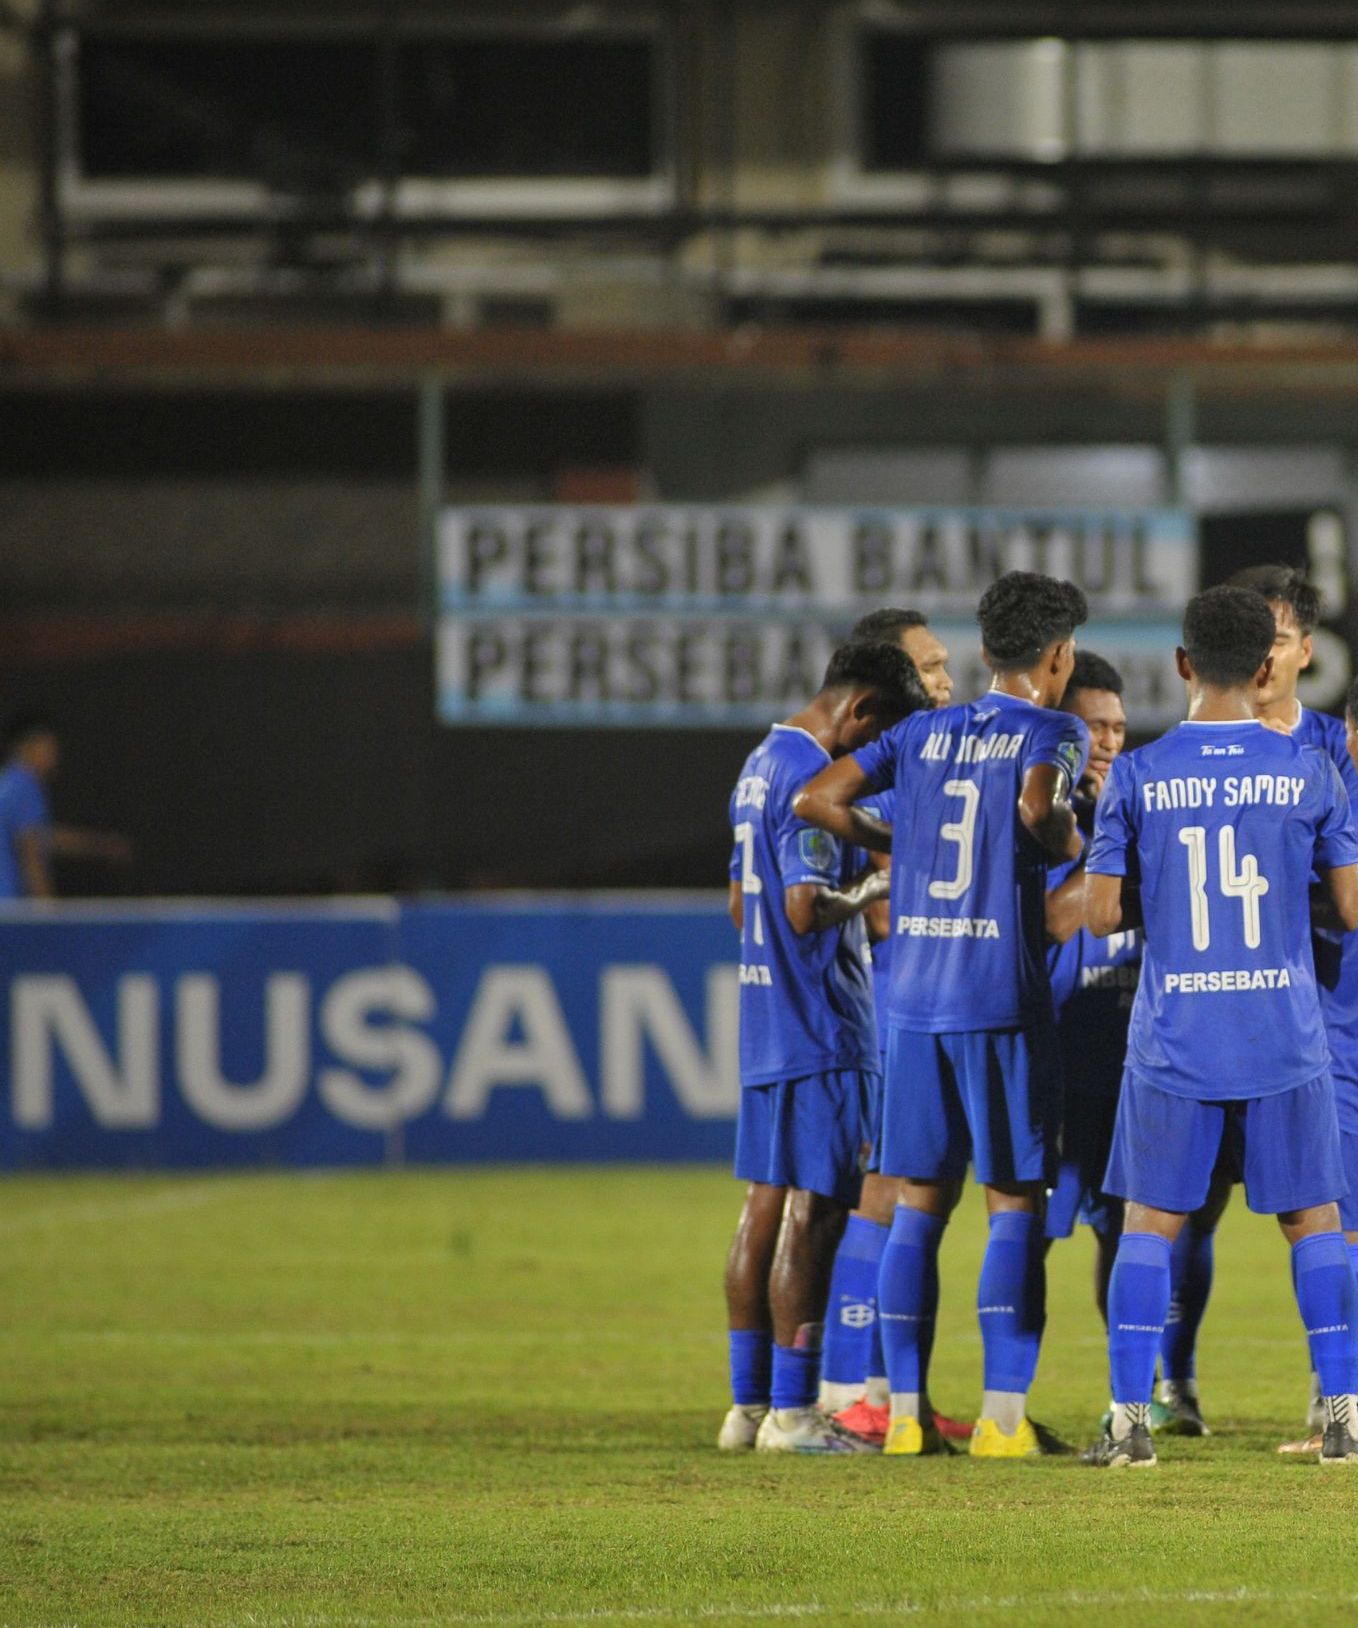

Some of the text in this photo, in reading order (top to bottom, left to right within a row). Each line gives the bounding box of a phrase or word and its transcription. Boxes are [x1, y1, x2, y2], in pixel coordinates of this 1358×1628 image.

[465, 514, 1160, 596] PERSIBA BANTUL
[465, 626, 850, 702] PERSEBA
[920, 732, 952, 760] ALI
[1143, 775, 1305, 812] FANDY SAMBY
[928, 779, 979, 899] 3
[1179, 825, 1269, 951] 14
[898, 916, 999, 939] PERSEBATA
[1165, 969, 1290, 993] PERSEBATA
[10, 963, 741, 1133] NUSAN
